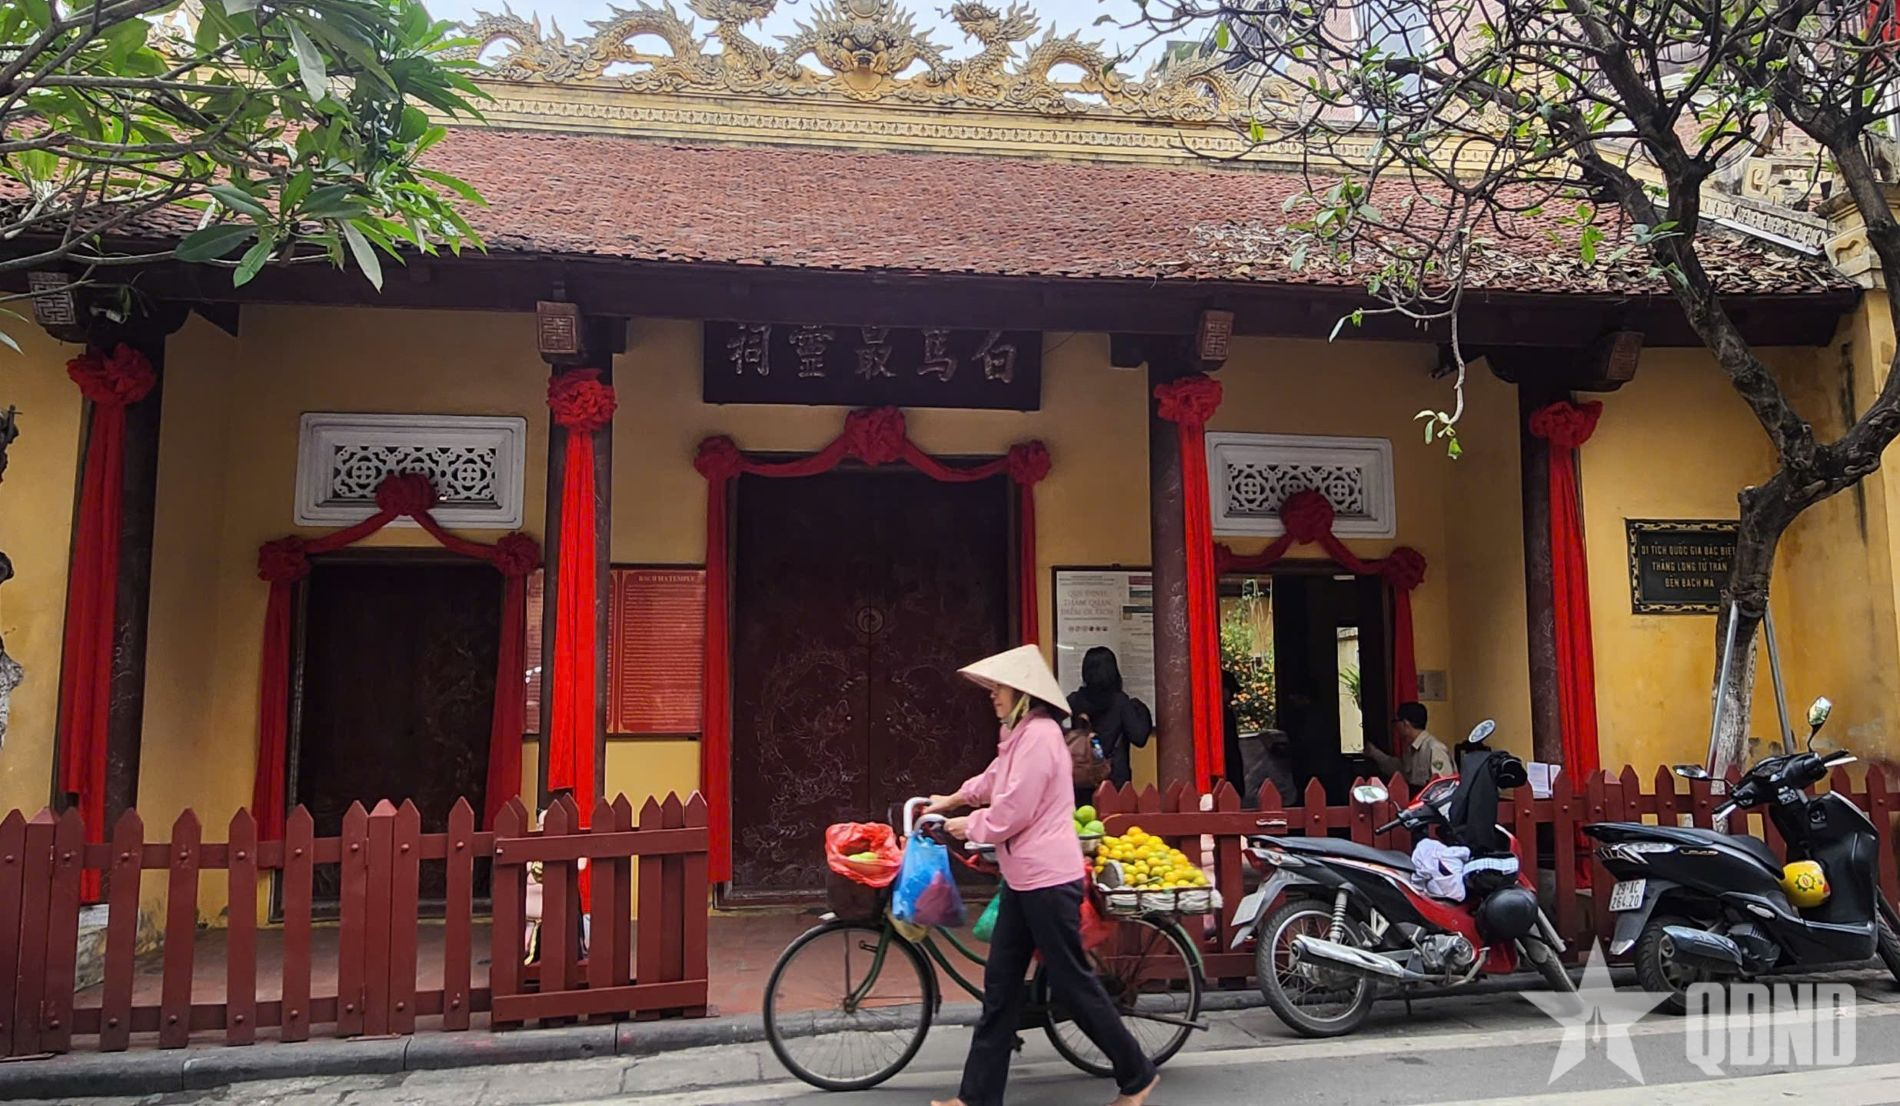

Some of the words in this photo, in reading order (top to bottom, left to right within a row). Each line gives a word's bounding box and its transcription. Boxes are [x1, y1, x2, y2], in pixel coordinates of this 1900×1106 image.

[1651, 541, 1667, 555] TÍCH
[1690, 546, 1702, 555] GIA
[1677, 562, 1697, 571] LONG
[1681, 578, 1701, 591] BẠCH
